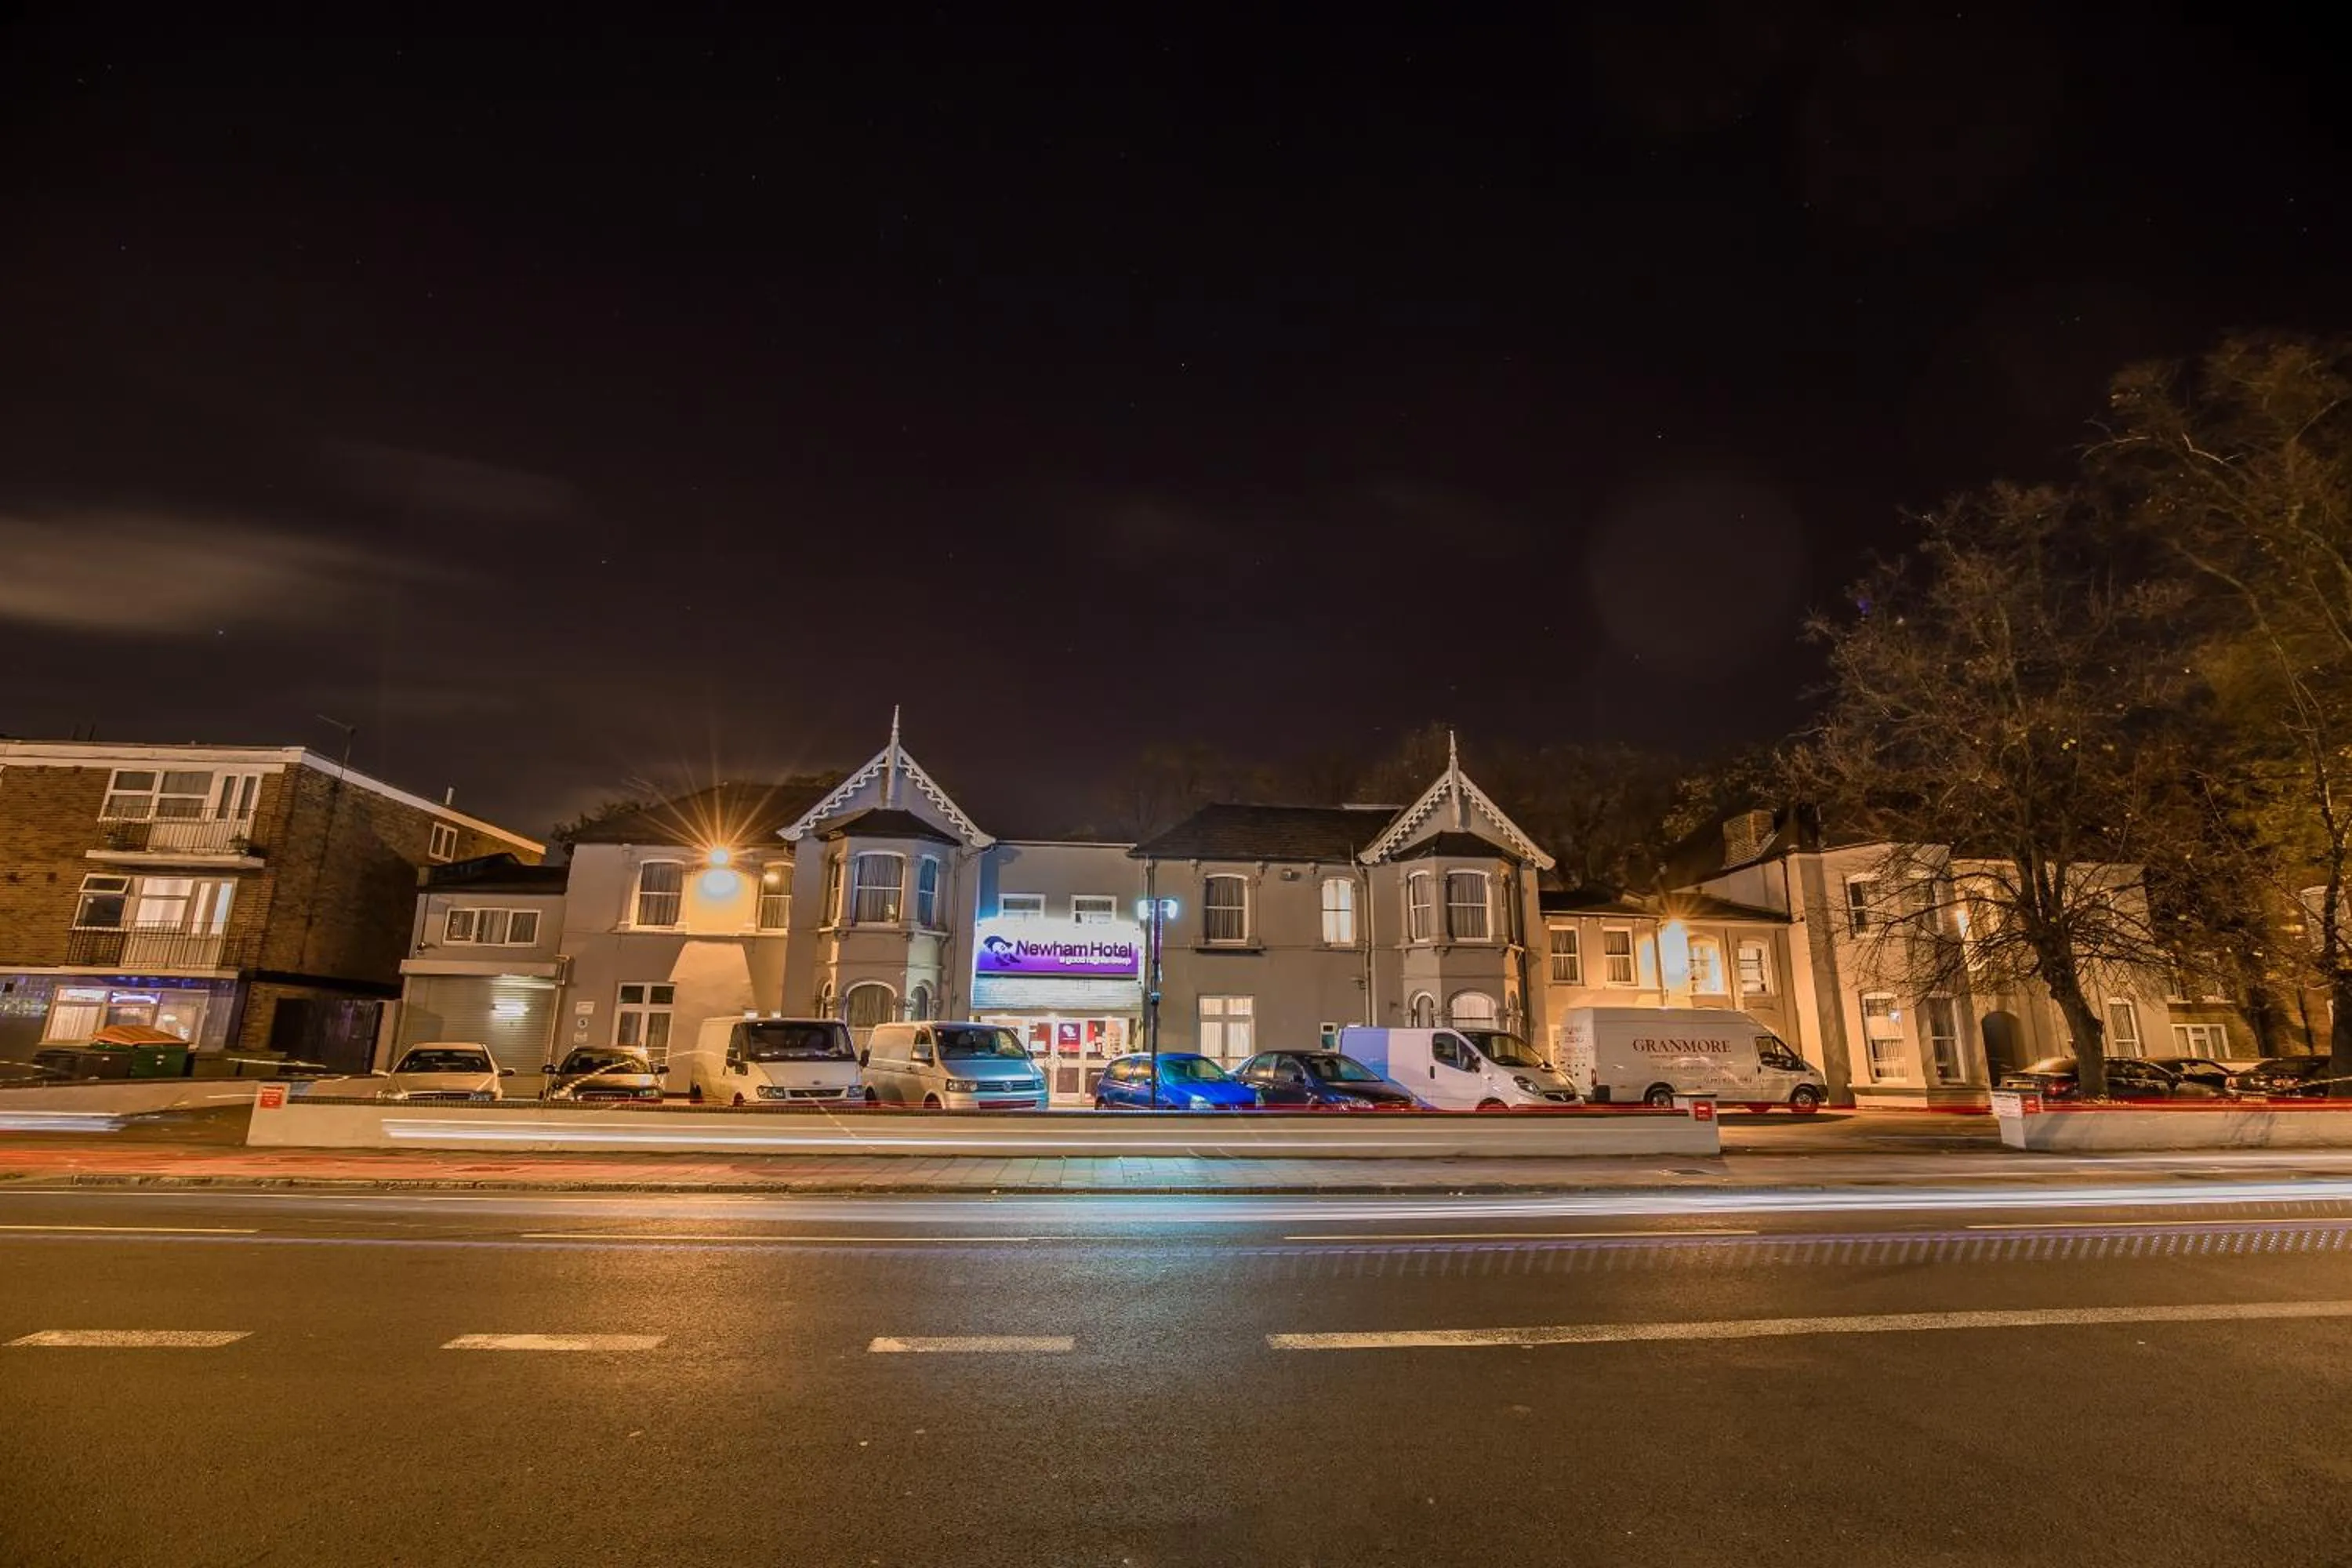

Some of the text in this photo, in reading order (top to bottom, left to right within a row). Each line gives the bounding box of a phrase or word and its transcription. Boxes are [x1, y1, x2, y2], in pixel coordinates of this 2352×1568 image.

[1017, 940, 1133, 957] Newham Hotel
[1633, 1039, 1731, 1053] GRANMORE
